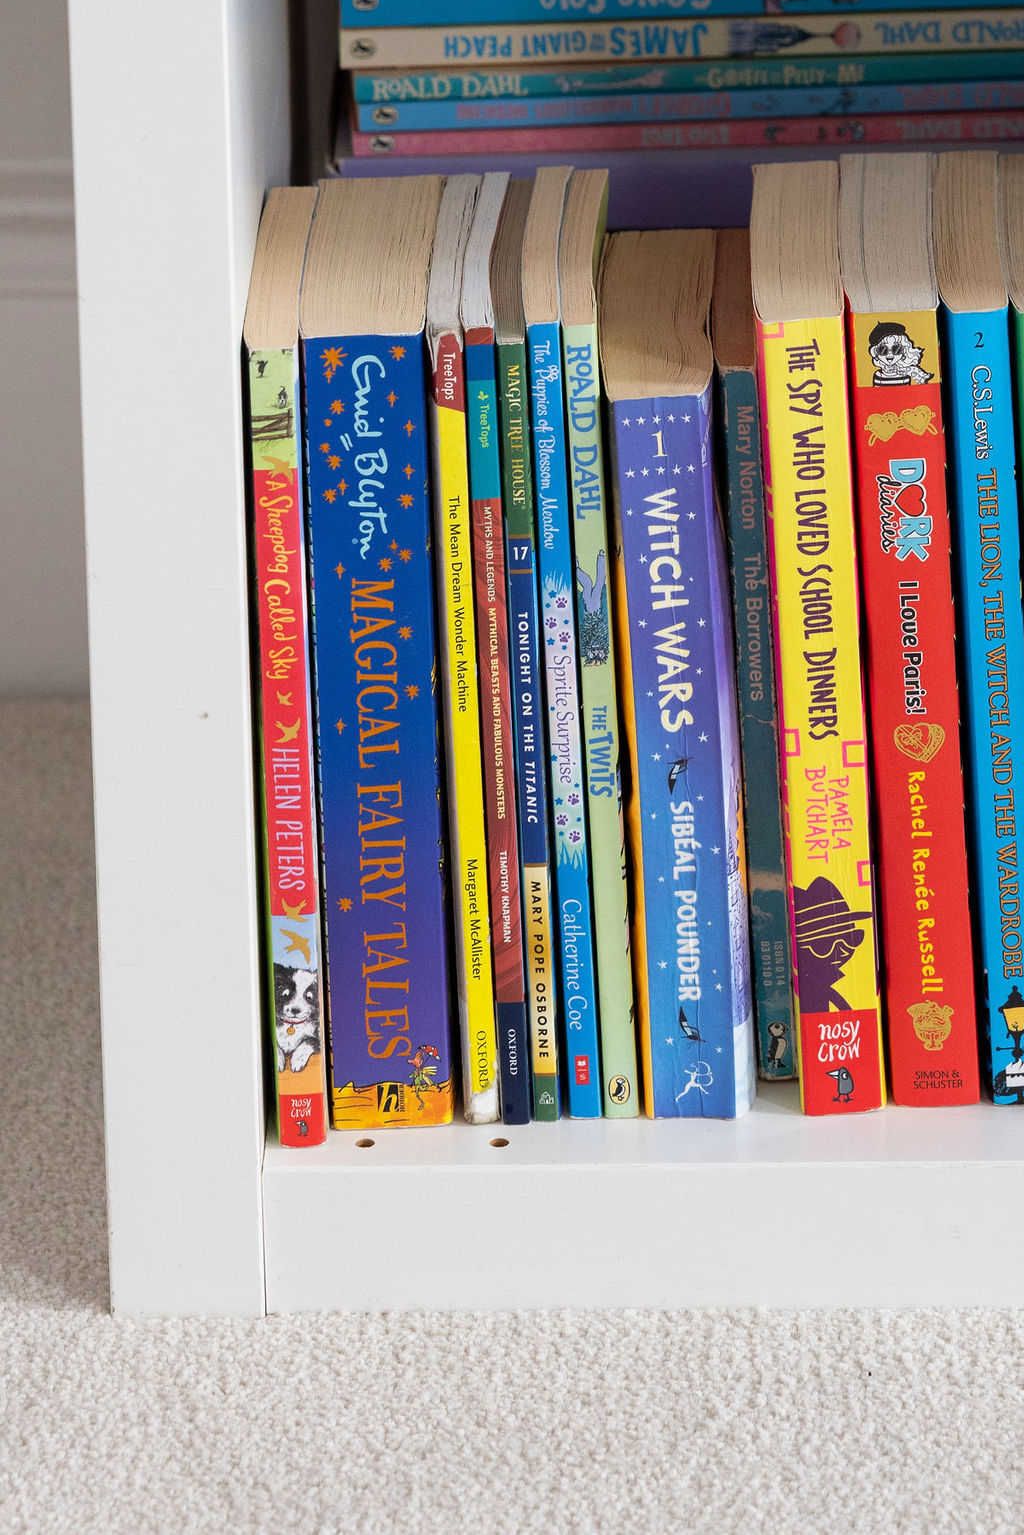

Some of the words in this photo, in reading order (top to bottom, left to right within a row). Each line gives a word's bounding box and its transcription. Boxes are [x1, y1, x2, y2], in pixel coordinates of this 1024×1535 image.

[444, 34, 513, 59] PEACH
[521, 30, 589, 58] GIANT
[610, 24, 710, 58] JAMES
[786, 338, 819, 372] THE
[566, 344, 598, 432] ROALD
[788, 379, 822, 416] SPY
[573, 444, 600, 518] DAHL
[792, 426, 824, 480] WHO
[448, 495, 460, 519] The
[976, 468, 998, 518] THE
[449, 524, 460, 557] Mean
[795, 489, 828, 555] LOVED
[513, 546, 529, 562] 17
[977, 521, 1002, 585] LION,
[451, 562, 462, 602] Dream
[798, 564, 832, 638] SCHOOL
[898, 580, 919, 589] I
[454, 606, 466, 655] Wonder
[898, 593, 922, 647] Love
[983, 590, 1005, 640] THE
[350, 577, 400, 770] MAGICAL
[518, 612, 530, 683] TONIGHT
[456, 660, 469, 711] Machine
[521, 692, 532, 715] ON
[804, 648, 837, 739] DINNERS
[901, 651, 926, 715] Paris!
[986, 644, 1009, 726] WITCH
[523, 724, 534, 751] THE
[990, 732, 1012, 784] AND
[271, 746, 301, 810] HELEN
[525, 761, 537, 822] TITANIC
[908, 771, 931, 837] Rachel
[670, 800, 701, 880] SIBÉAL
[993, 788, 1015, 838] THE
[275, 819, 305, 891] PETERS
[357, 782, 407, 913] FAIRY
[912, 848, 934, 910] Renée
[997, 842, 1022, 978] WARDROBE
[562, 899, 583, 989] Catherine
[673, 889, 700, 1001] POUNDER
[917, 917, 943, 993] Russell
[362, 921, 412, 1059] TALES
[567, 995, 586, 1029] Coe
[507, 1028, 517, 1075] OXFORD
